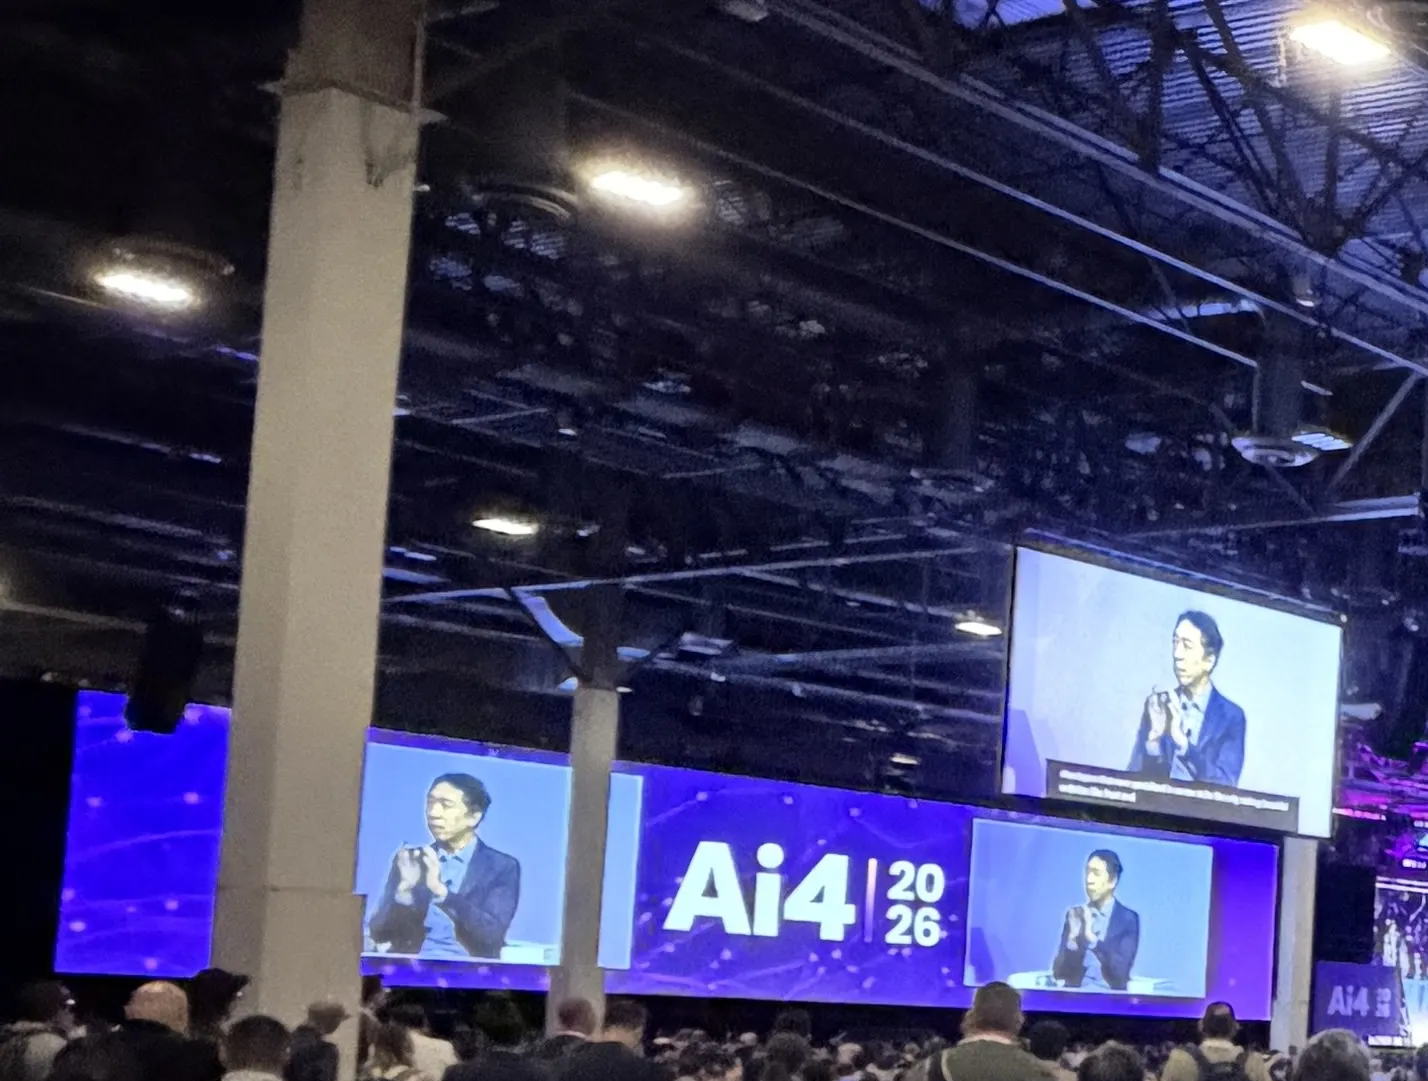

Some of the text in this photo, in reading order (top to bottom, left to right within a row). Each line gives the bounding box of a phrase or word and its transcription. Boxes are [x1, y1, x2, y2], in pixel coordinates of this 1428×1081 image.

[662, 841, 856, 941] Ai4
[886, 860, 945, 902] 20
[885, 905, 941, 947] 26
[1327, 985, 1369, 1017] Ai4
